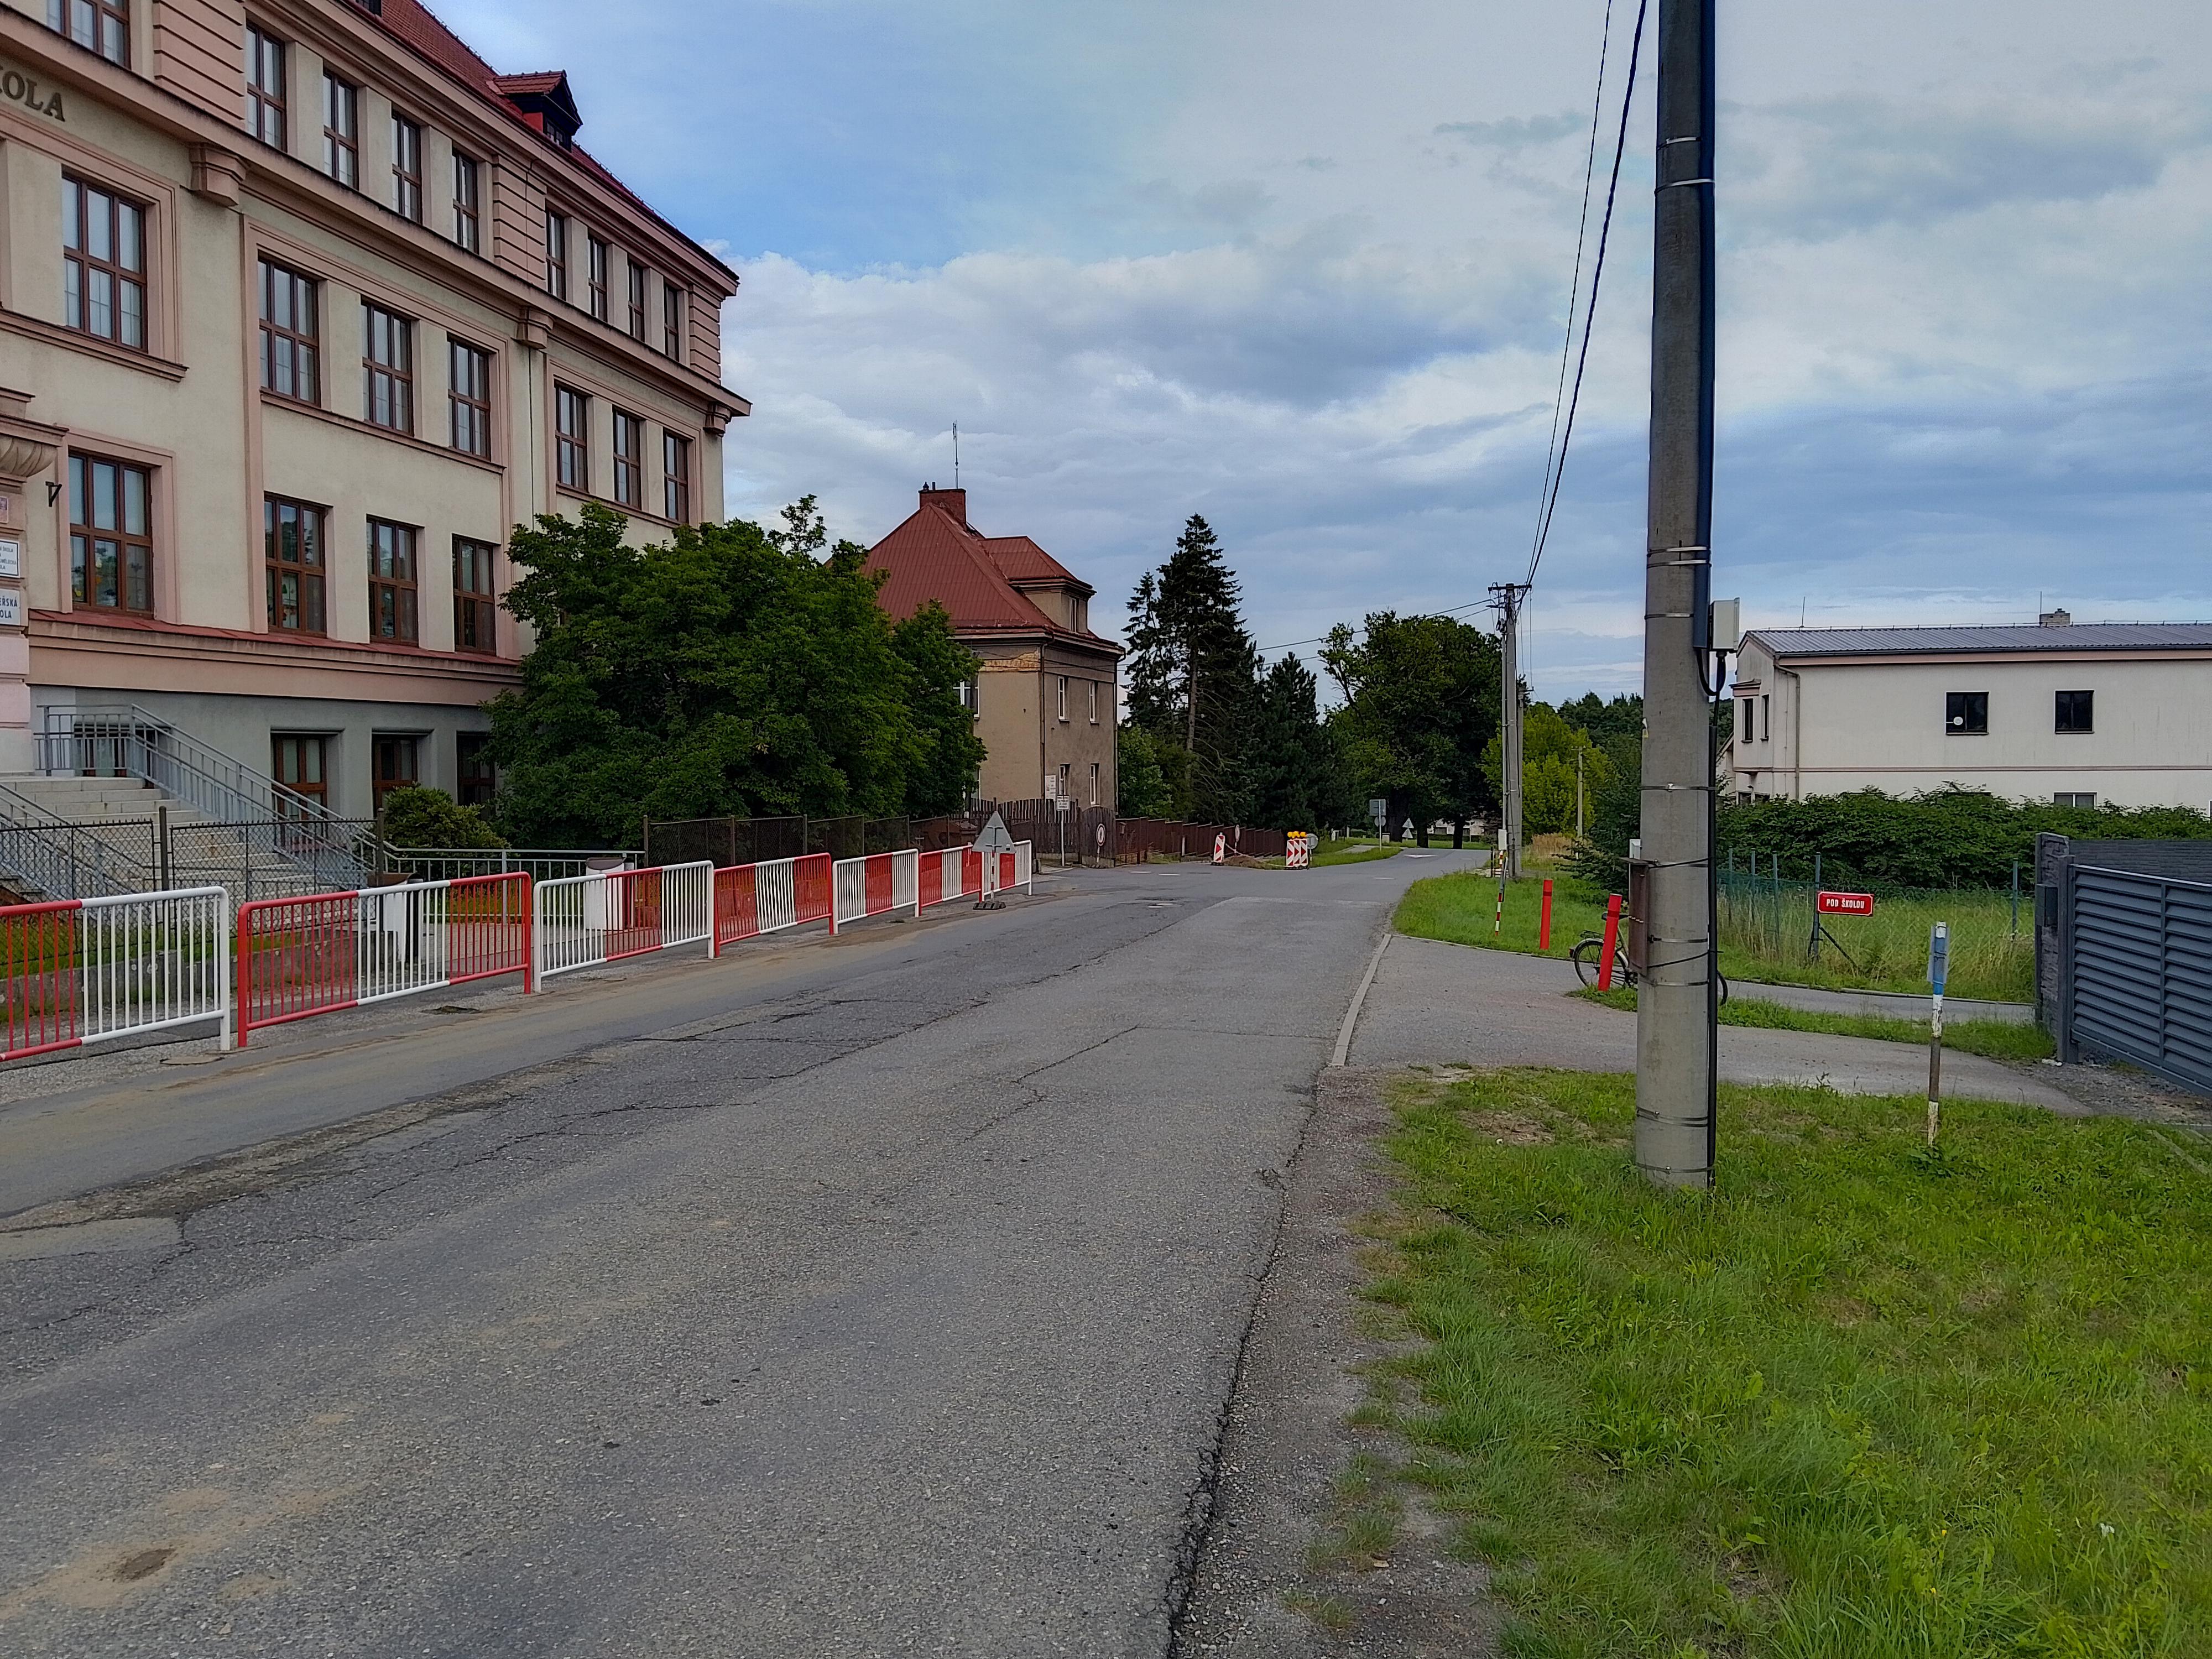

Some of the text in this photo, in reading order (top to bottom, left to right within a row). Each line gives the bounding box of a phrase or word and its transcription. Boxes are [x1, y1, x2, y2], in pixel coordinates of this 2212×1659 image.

[0, 65, 65, 122] OLA
[1826, 898, 1865, 909] POD ŠKOLOU
